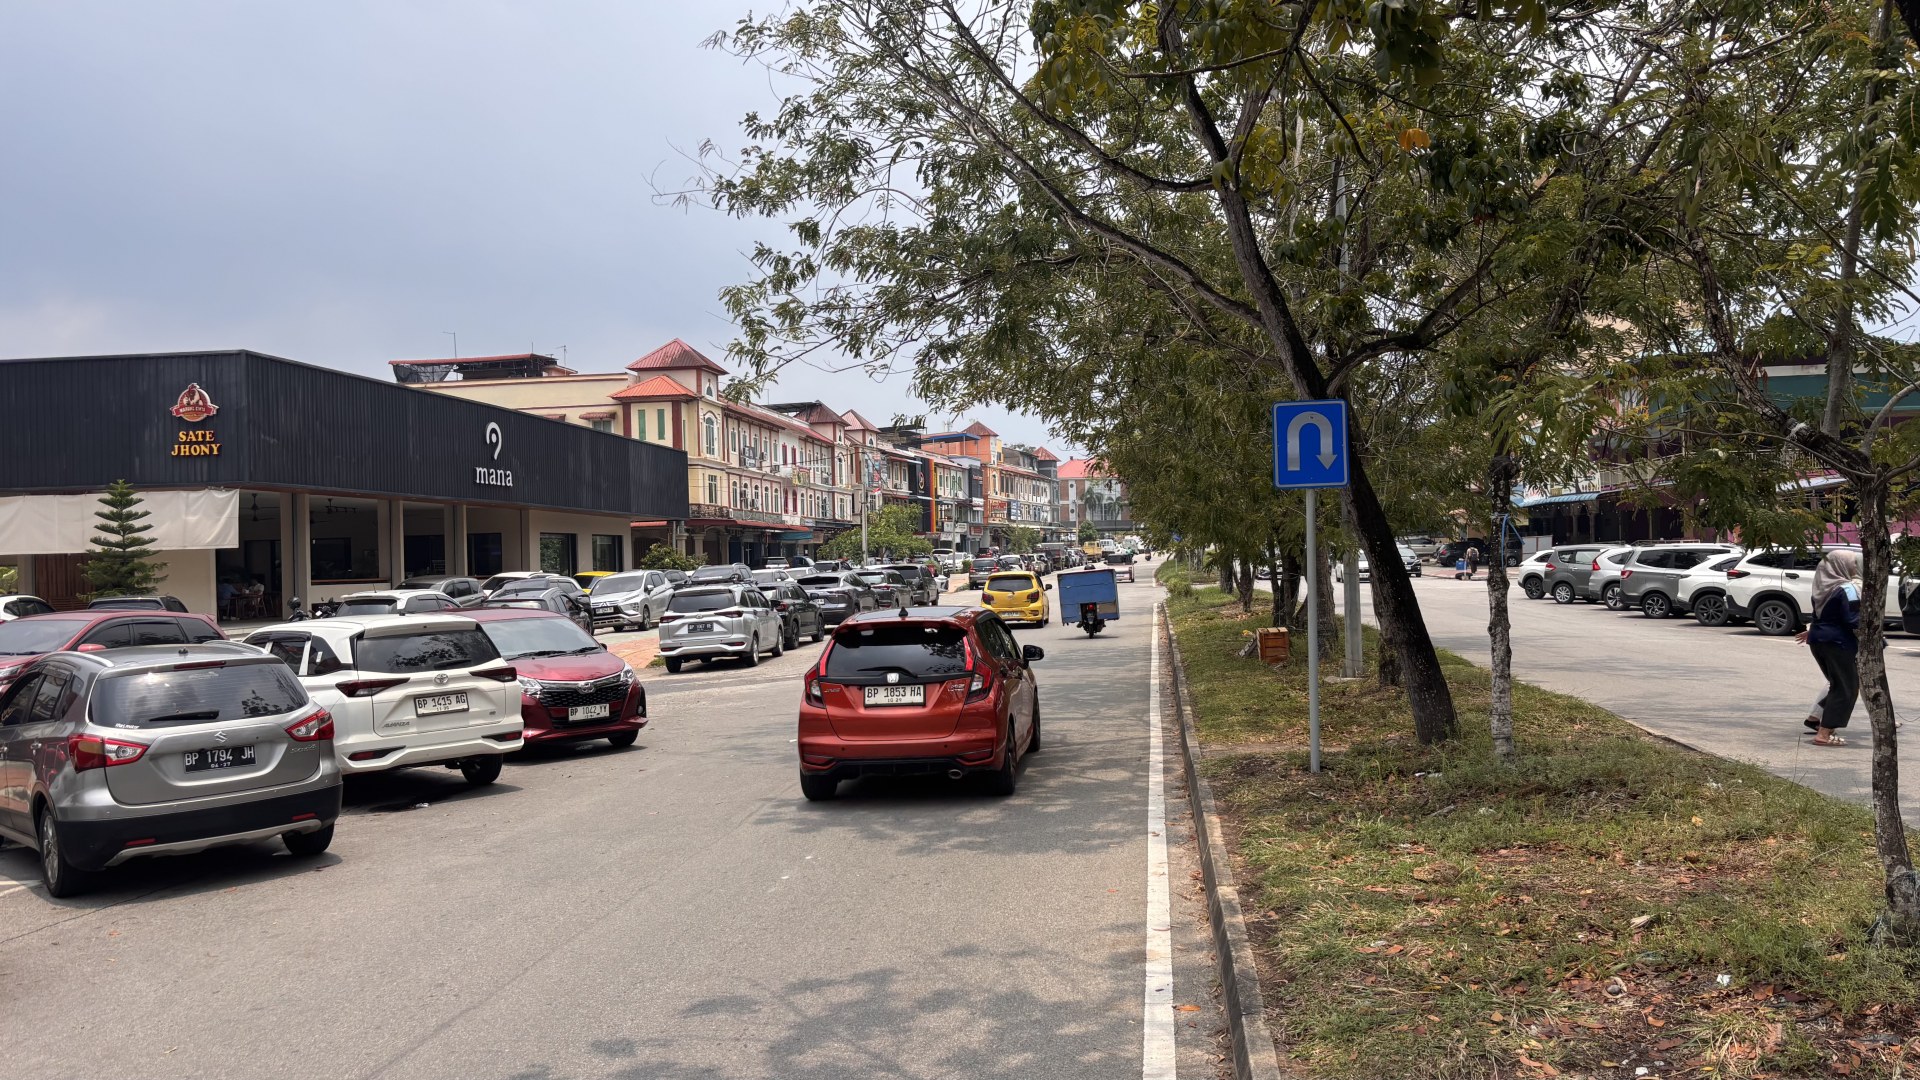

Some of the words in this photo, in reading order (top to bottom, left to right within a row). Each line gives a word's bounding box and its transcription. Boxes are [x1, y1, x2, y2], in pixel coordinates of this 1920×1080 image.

[178, 430, 215, 442] SATE
[171, 443, 221, 456] JHONY
[474, 466, 513, 487] mana
[867, 687, 879, 698] BP
[884, 686, 907, 698] 1853
[910, 686, 922, 697] HA
[417, 699, 428, 709] BP
[432, 696, 452, 708] 1415
[455, 694, 466, 704] AG
[570, 708, 579, 717] BP
[185, 752, 199, 766] BP
[206, 748, 233, 763] 1794
[241, 746, 255, 760] JH
